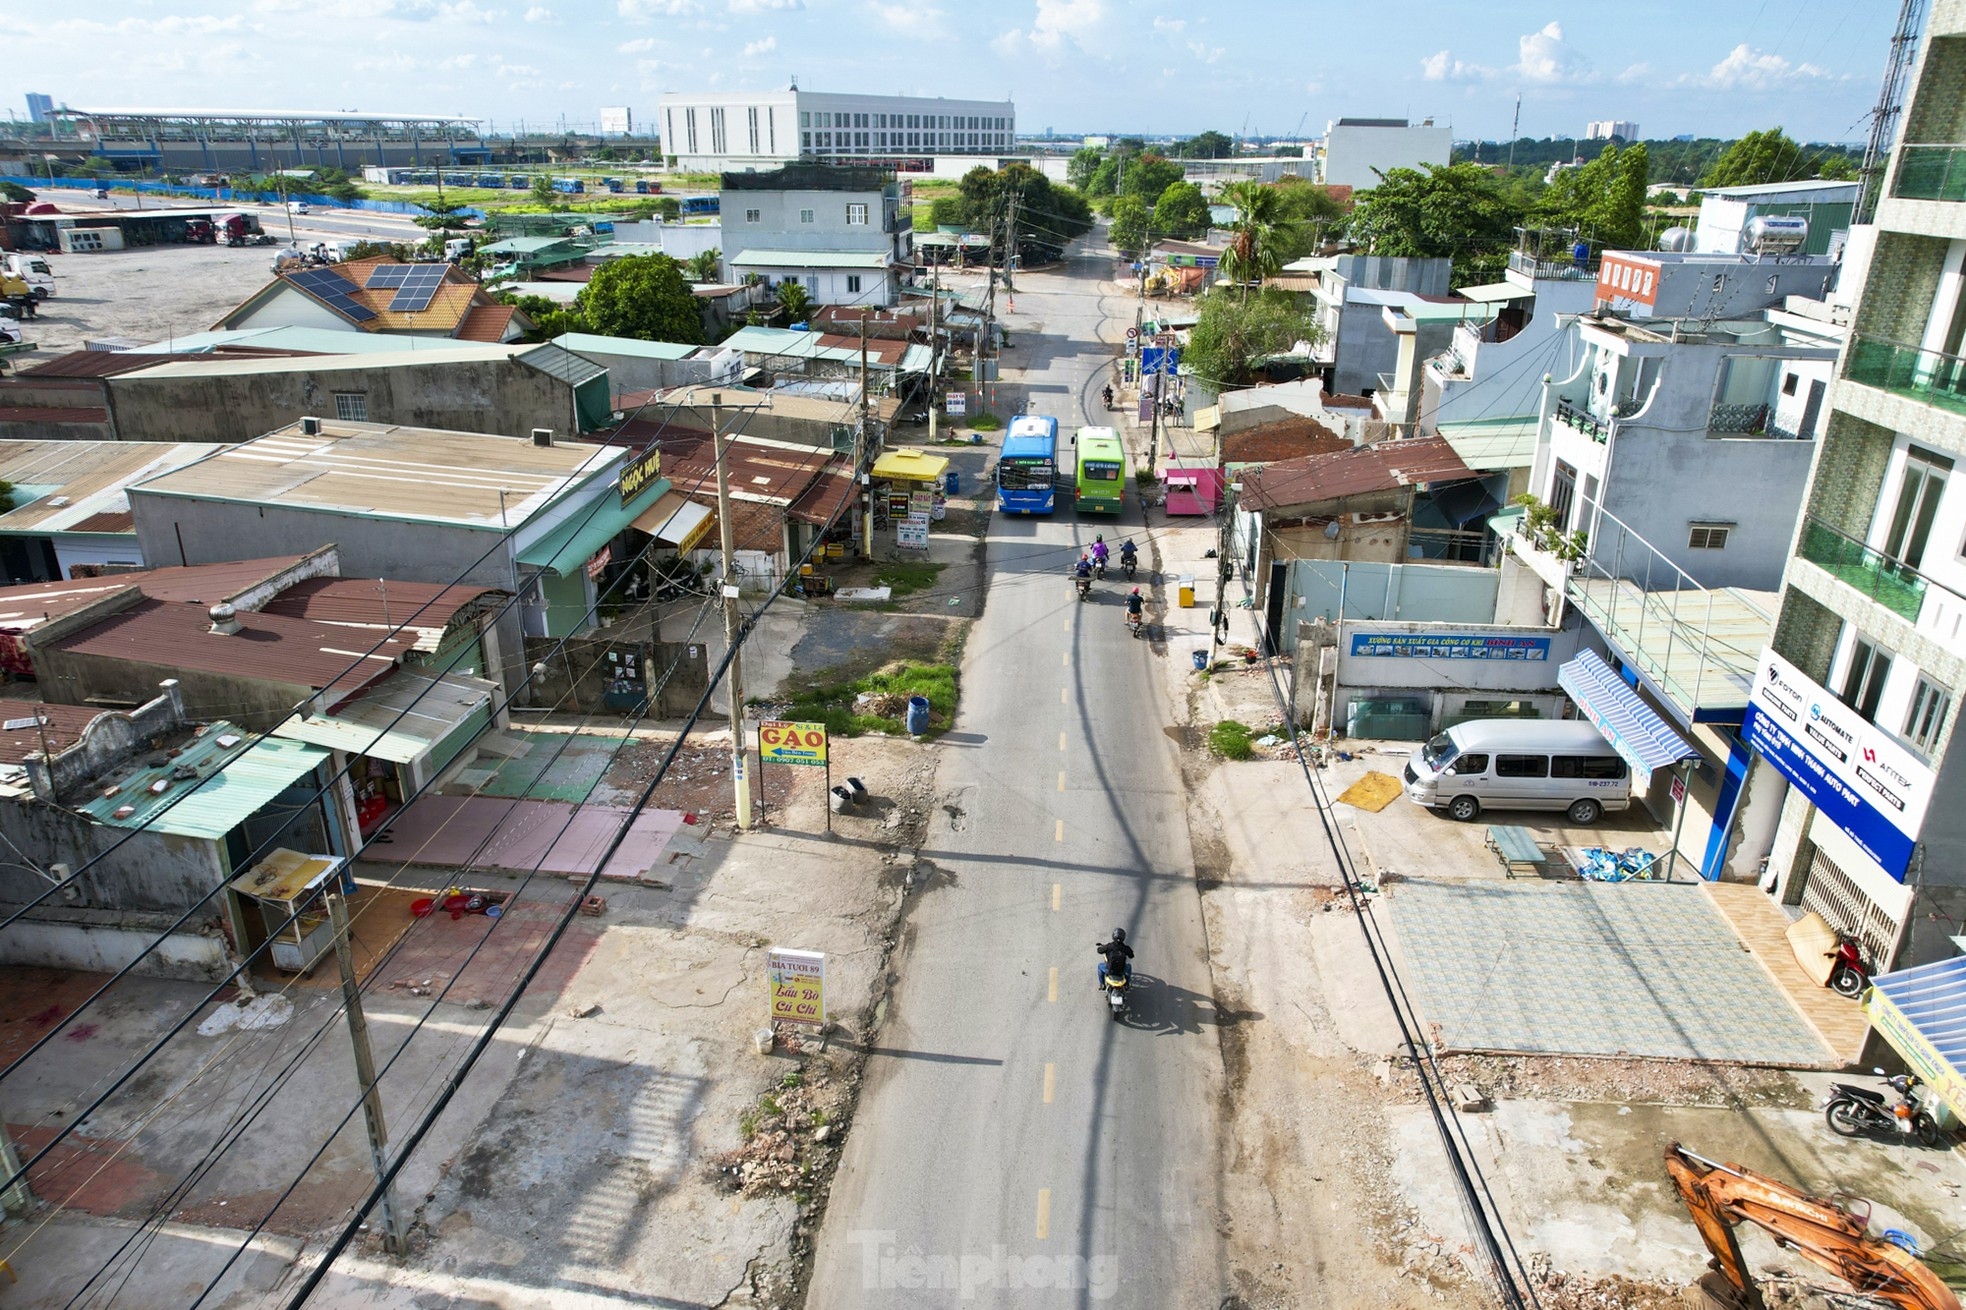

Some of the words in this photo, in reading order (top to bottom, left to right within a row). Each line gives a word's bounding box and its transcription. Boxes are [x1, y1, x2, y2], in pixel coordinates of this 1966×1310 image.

[622, 465, 644, 496] NGỌC
[1407, 636, 1426, 645] XUẤT
[1427, 638, 1440, 646] GIA
[1440, 638, 1460, 646] CÔNG
[1517, 640, 1537, 648] AN
[762, 729, 824, 749] GẠO
[1600, 724, 1616, 745] AN
[1820, 715, 1854, 745] AUTOMATE
[1825, 738, 1843, 759] PARTS
[1769, 723, 1778, 735] TY
[1824, 773, 1843, 792] AUTO
[1841, 788, 1861, 808] PART
[1858, 768, 1883, 793] PERFECT
[1882, 787, 1902, 808] PARTS
[810, 965, 820, 973] 89
[802, 988, 819, 1000] Bò
[775, 1000, 793, 1012] Củ
